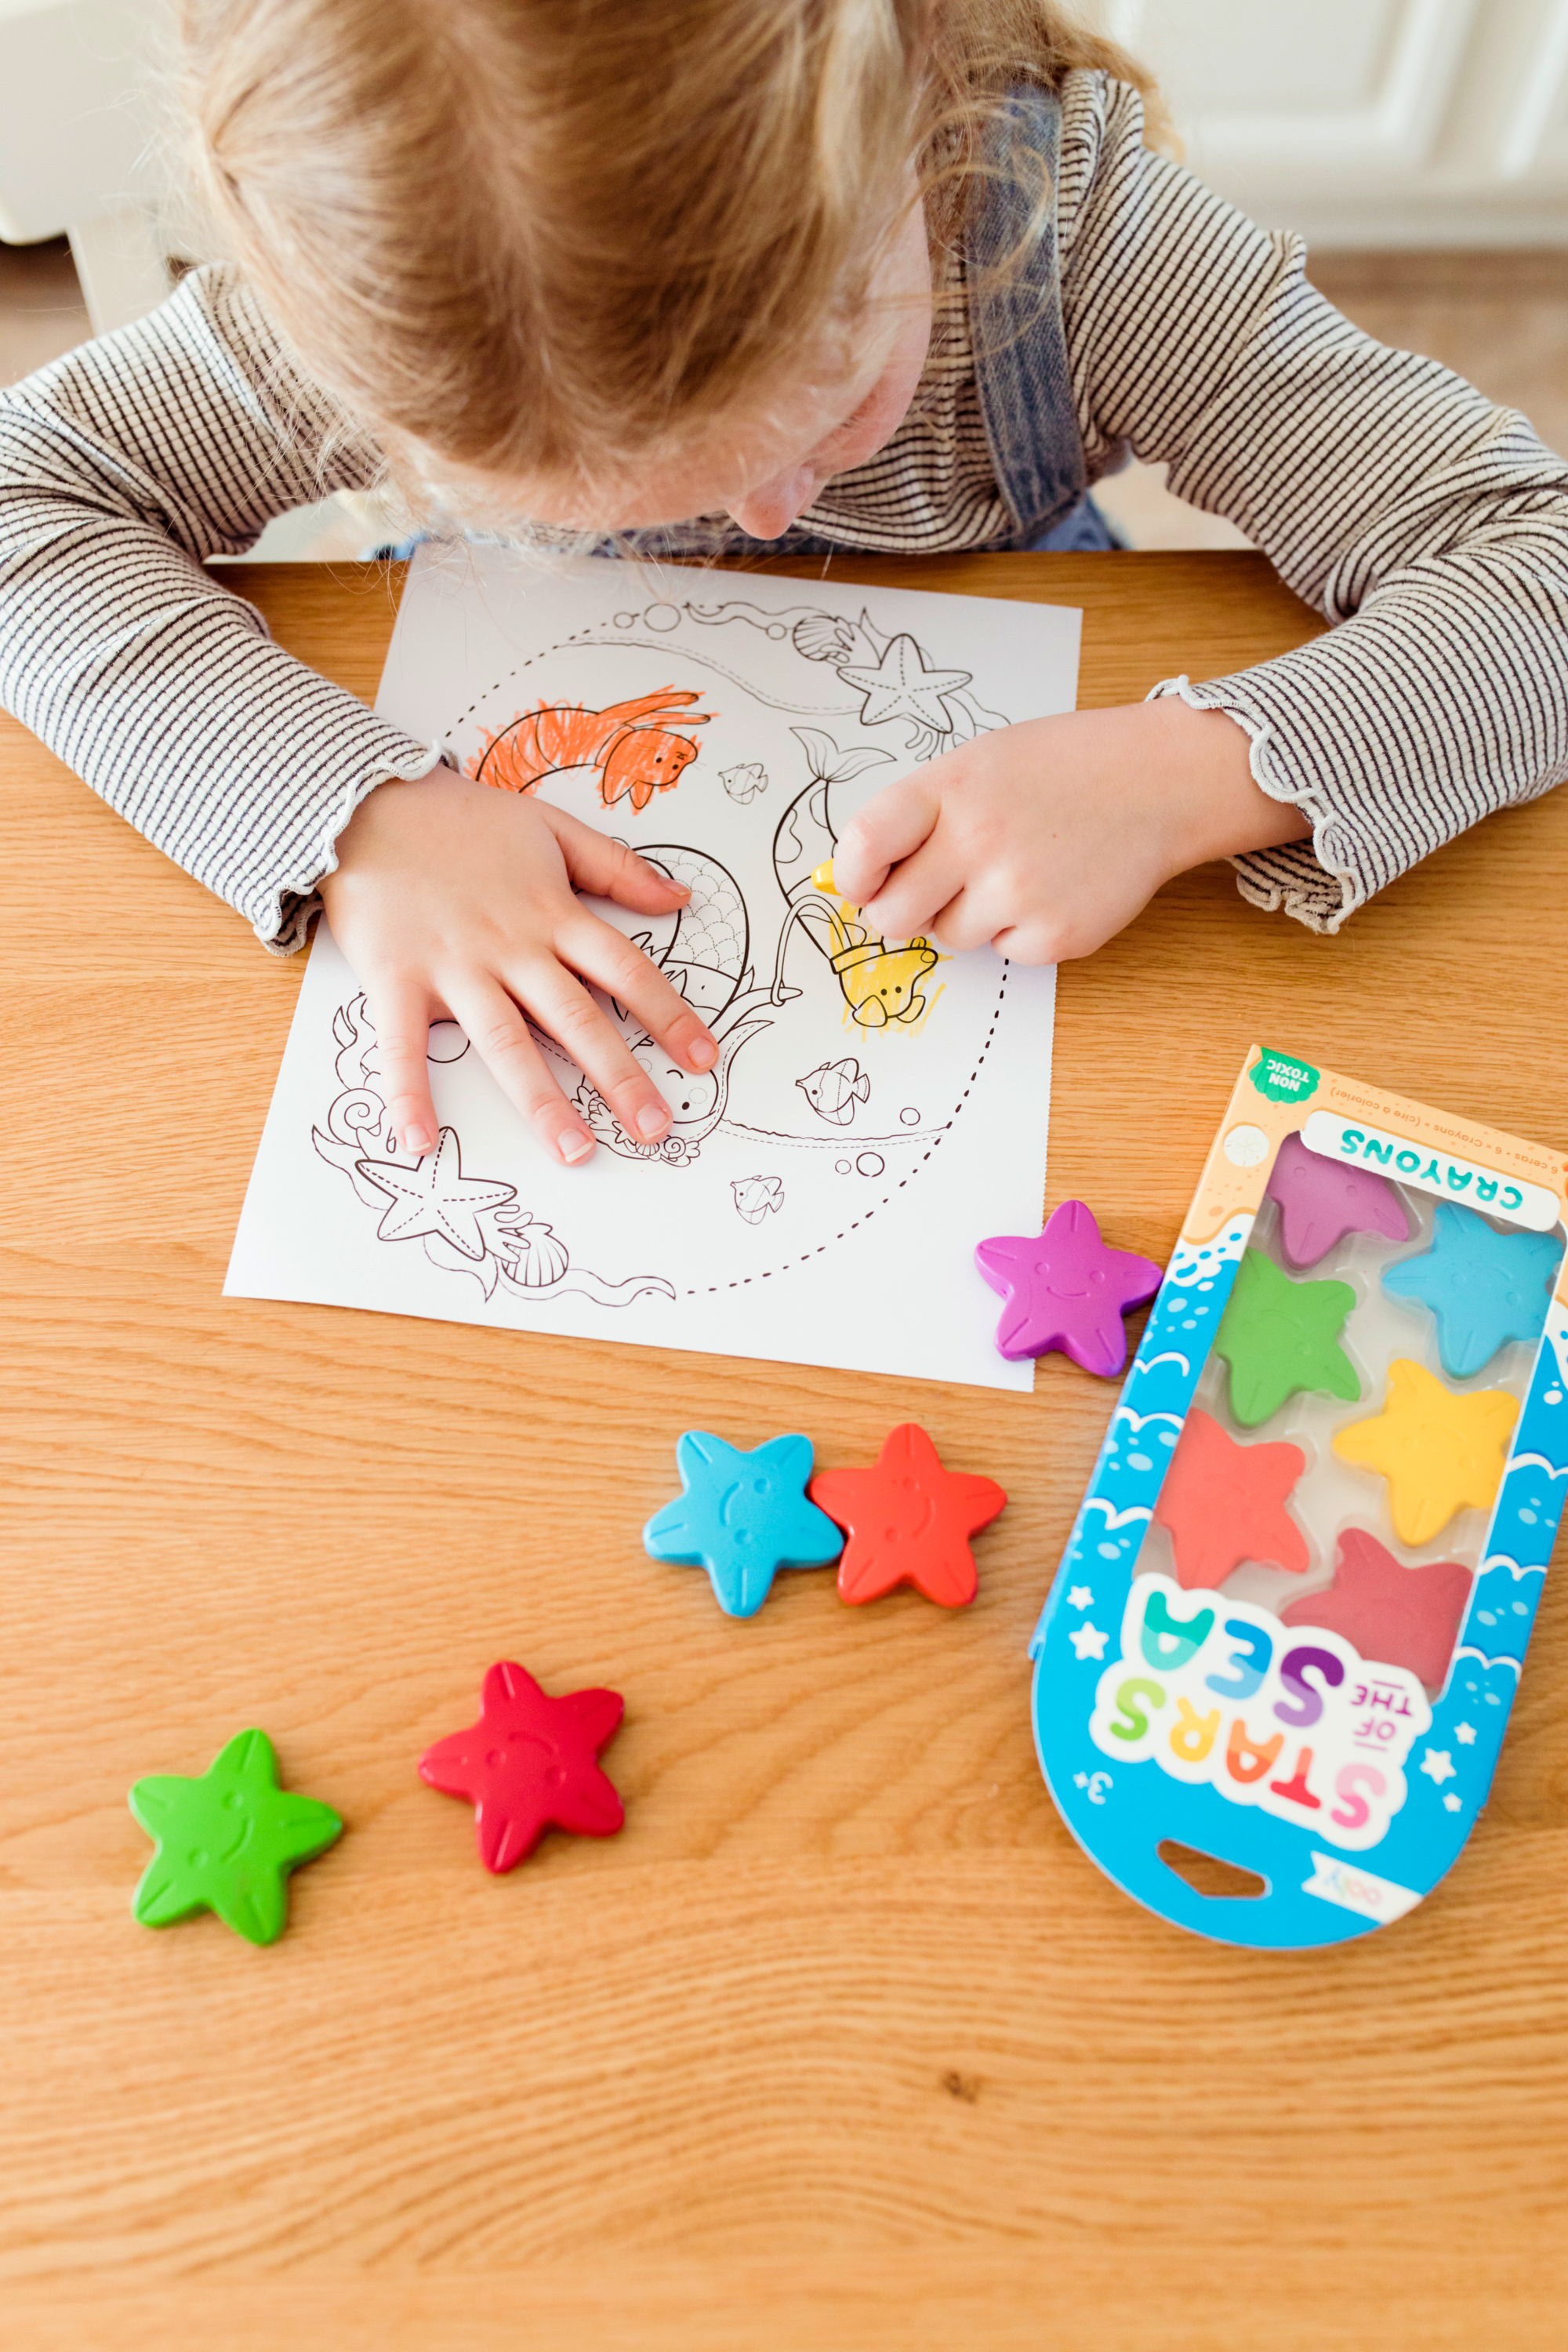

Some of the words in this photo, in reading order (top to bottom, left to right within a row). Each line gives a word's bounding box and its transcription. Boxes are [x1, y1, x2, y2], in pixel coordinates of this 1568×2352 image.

[1266, 1059, 1309, 1082] TOXIC
[1269, 1073, 1301, 1092] NON
[1330, 1087, 1380, 1110] colorier)
[1383, 1105, 1390, 1116] à
[1393, 1109, 1421, 1127] (cire
[1433, 1123, 1483, 1148] Crayons
[1494, 1146, 1502, 1155] 6
[1514, 1152, 1548, 1171] ceras
[1340, 1129, 1523, 1210] CRAYONS
[1550, 1166, 1558, 1174] 6
[1141, 1591, 1345, 1727] SEA
[1349, 1685, 1412, 1716] THE
[1354, 1717, 1396, 1741] OF
[1109, 1678, 1387, 1830] STARS
[1073, 1771, 1113, 1805] 3+
